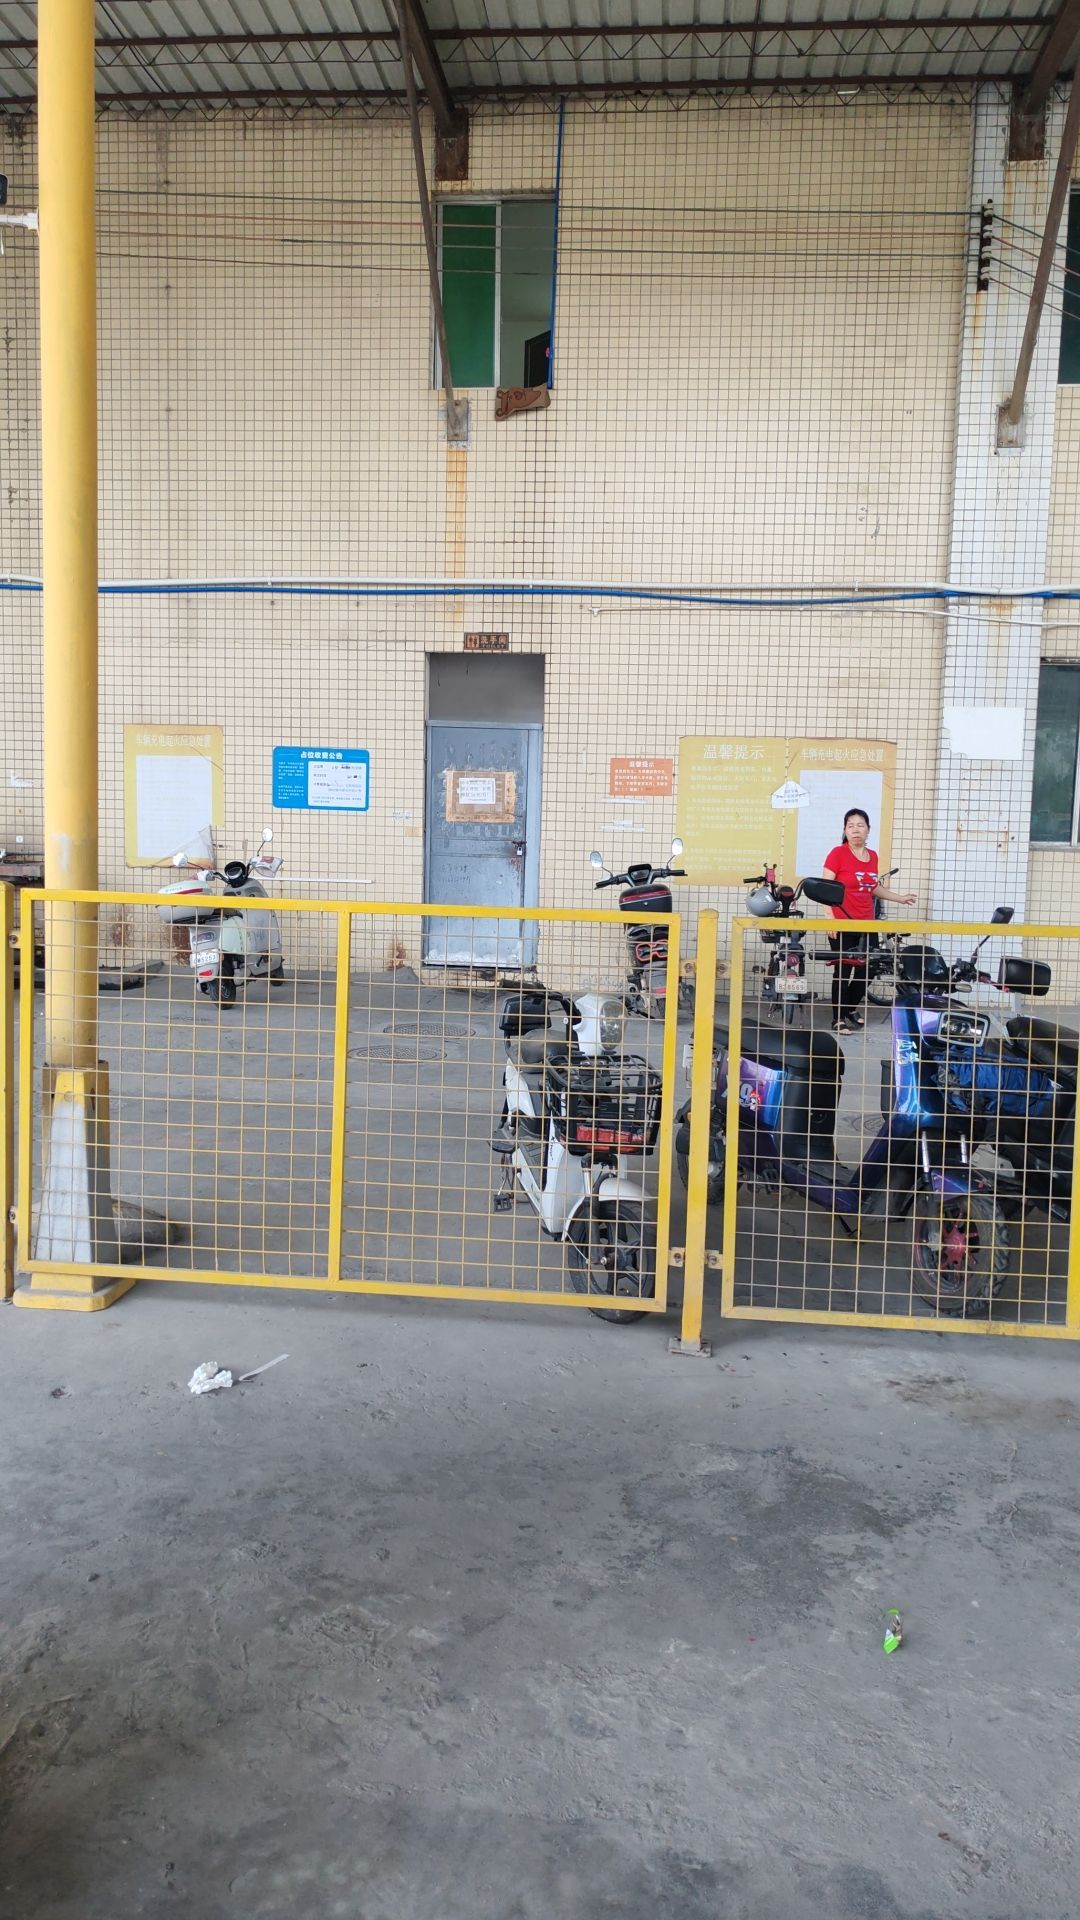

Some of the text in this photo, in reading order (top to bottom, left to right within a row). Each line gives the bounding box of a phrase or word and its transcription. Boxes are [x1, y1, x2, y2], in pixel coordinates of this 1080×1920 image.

[300, 751, 343, 760] 占位收费公告
[703, 744, 766, 760] 温馨提示
